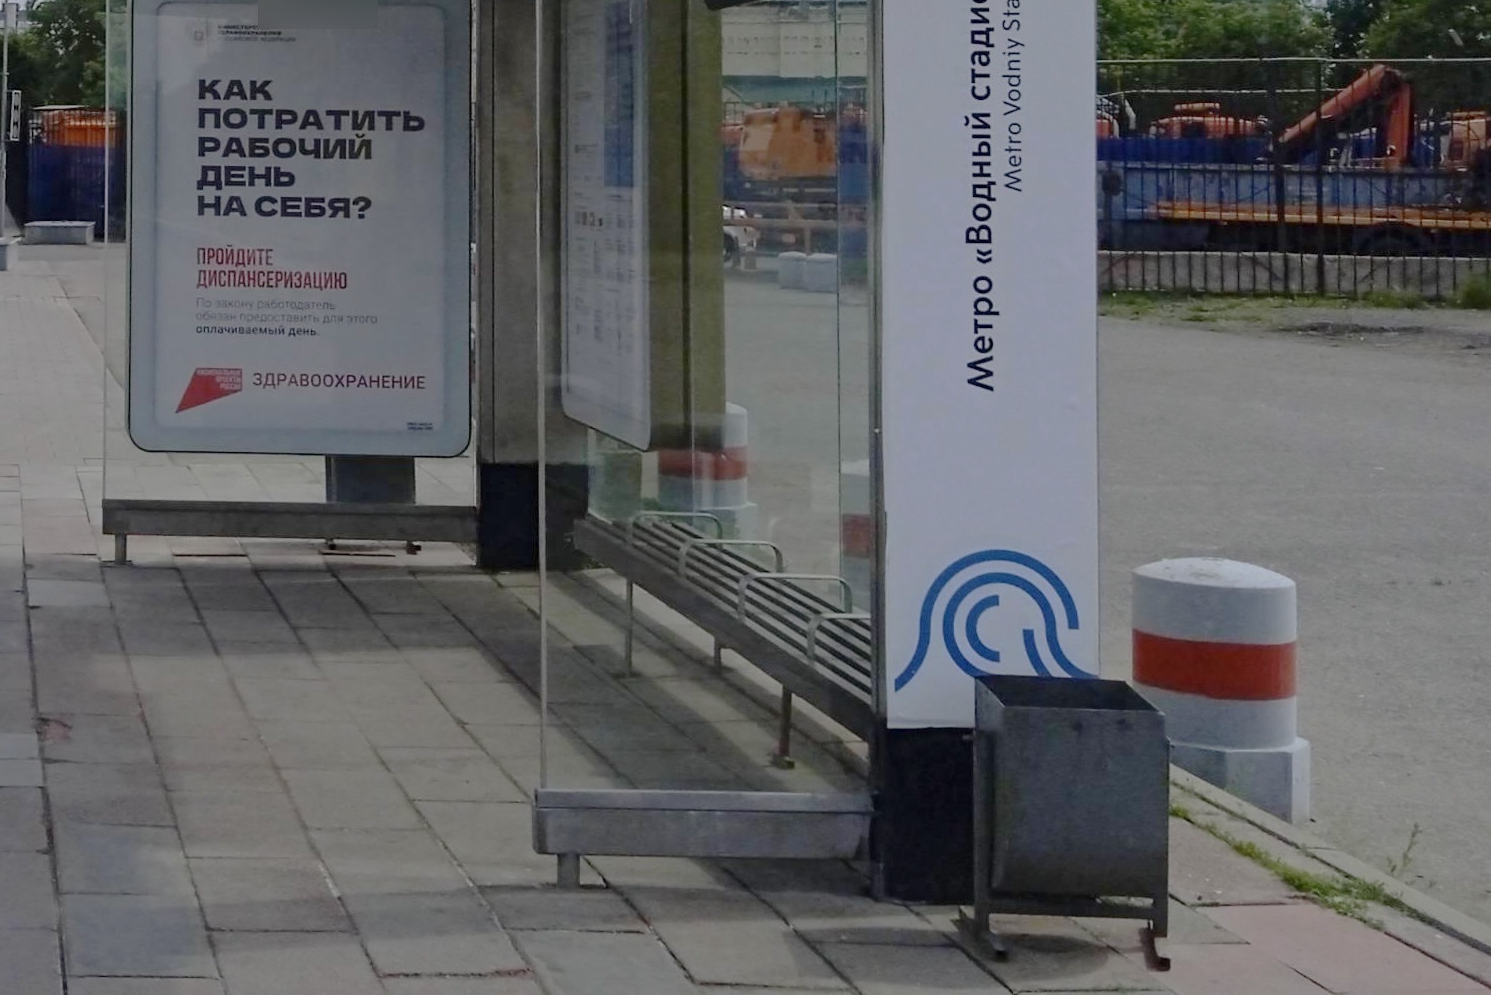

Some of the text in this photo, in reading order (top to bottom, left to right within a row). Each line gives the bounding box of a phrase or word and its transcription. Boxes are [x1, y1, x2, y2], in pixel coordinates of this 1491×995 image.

[1001, 38, 1025, 116] Vodniy
[198, 79, 273, 101] КАК
[198, 107, 426, 132] ПОТРАТИТЬ
[197, 134, 372, 160] РАБОЧИЙ
[1004, 123, 1022, 193] Metro
[196, 165, 296, 191] ДЕНЬ
[964, 112, 997, 264] «Водный
[197, 195, 372, 220] НА СЕБЯ?
[196, 245, 274, 267] ПРОЙДИТЕ
[196, 269, 348, 291] ДИСПАНСЕРИЗАЦИЮ
[195, 324, 285, 335] оплачиваемый
[966, 275, 1000, 392] Метро
[252, 372, 426, 390] ЗДРАВООХРАНЕНИЕ
